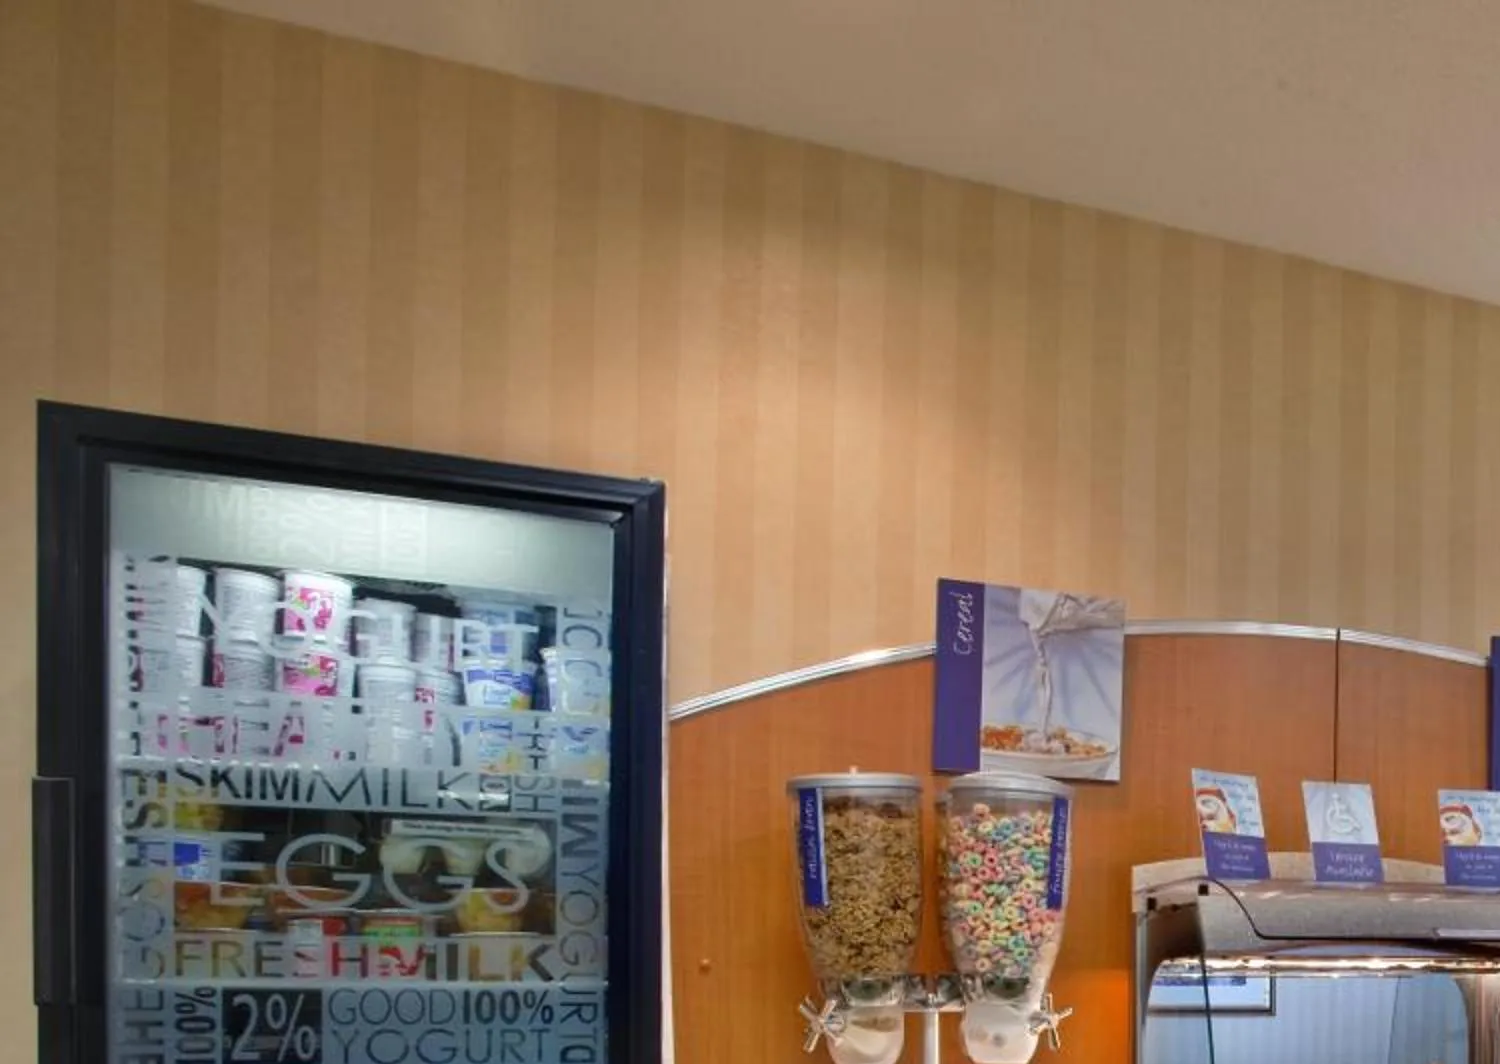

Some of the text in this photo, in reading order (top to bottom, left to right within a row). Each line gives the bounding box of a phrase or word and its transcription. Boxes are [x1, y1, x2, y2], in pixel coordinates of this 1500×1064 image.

[948, 589, 975, 656] Cereal
[209, 831, 530, 914] EGGS
[229, 992, 317, 1063] 2%
[327, 987, 555, 1026] GOOD 100%
